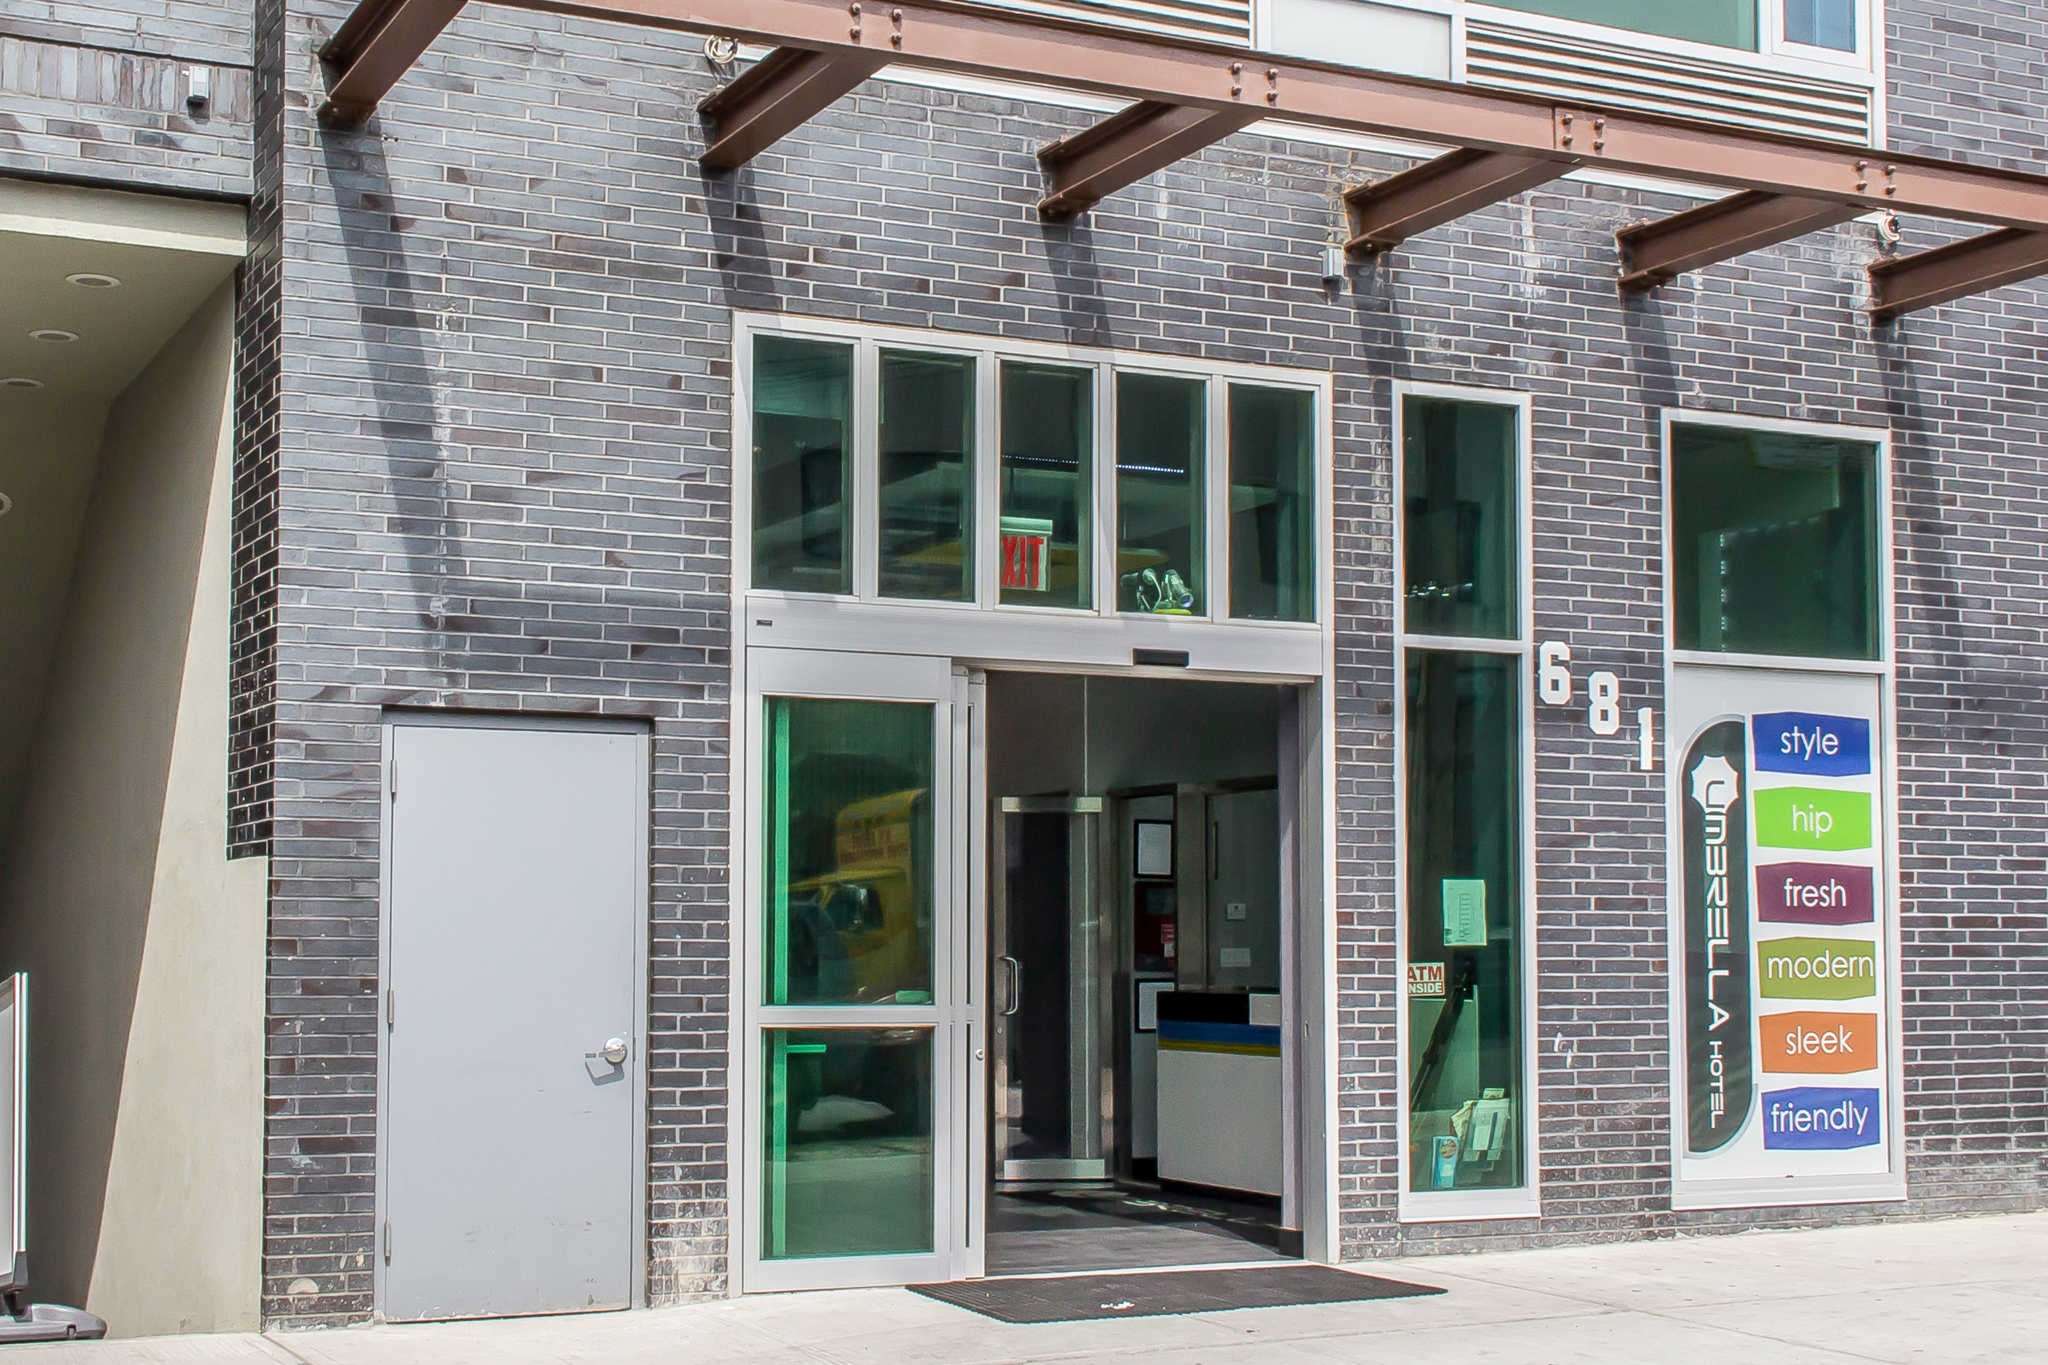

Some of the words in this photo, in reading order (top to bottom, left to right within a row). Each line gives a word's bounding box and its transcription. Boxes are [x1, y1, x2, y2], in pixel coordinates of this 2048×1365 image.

[1002, 536, 1043, 587] XIT
[1538, 640, 1653, 770] 681
[1780, 726, 1839, 760] style
[1791, 804, 1833, 839] hip
[1705, 780, 1730, 1031] UMBRELLA
[1783, 877, 1847, 908] fresh
[1408, 966, 1442, 981] ATM
[1767, 950, 1874, 979] modern
[1408, 983, 1443, 994] NSIDE
[1785, 1024, 1853, 1055] sleek
[1709, 1041, 1724, 1129] HOTEL
[1770, 1100, 1868, 1136] friendly
